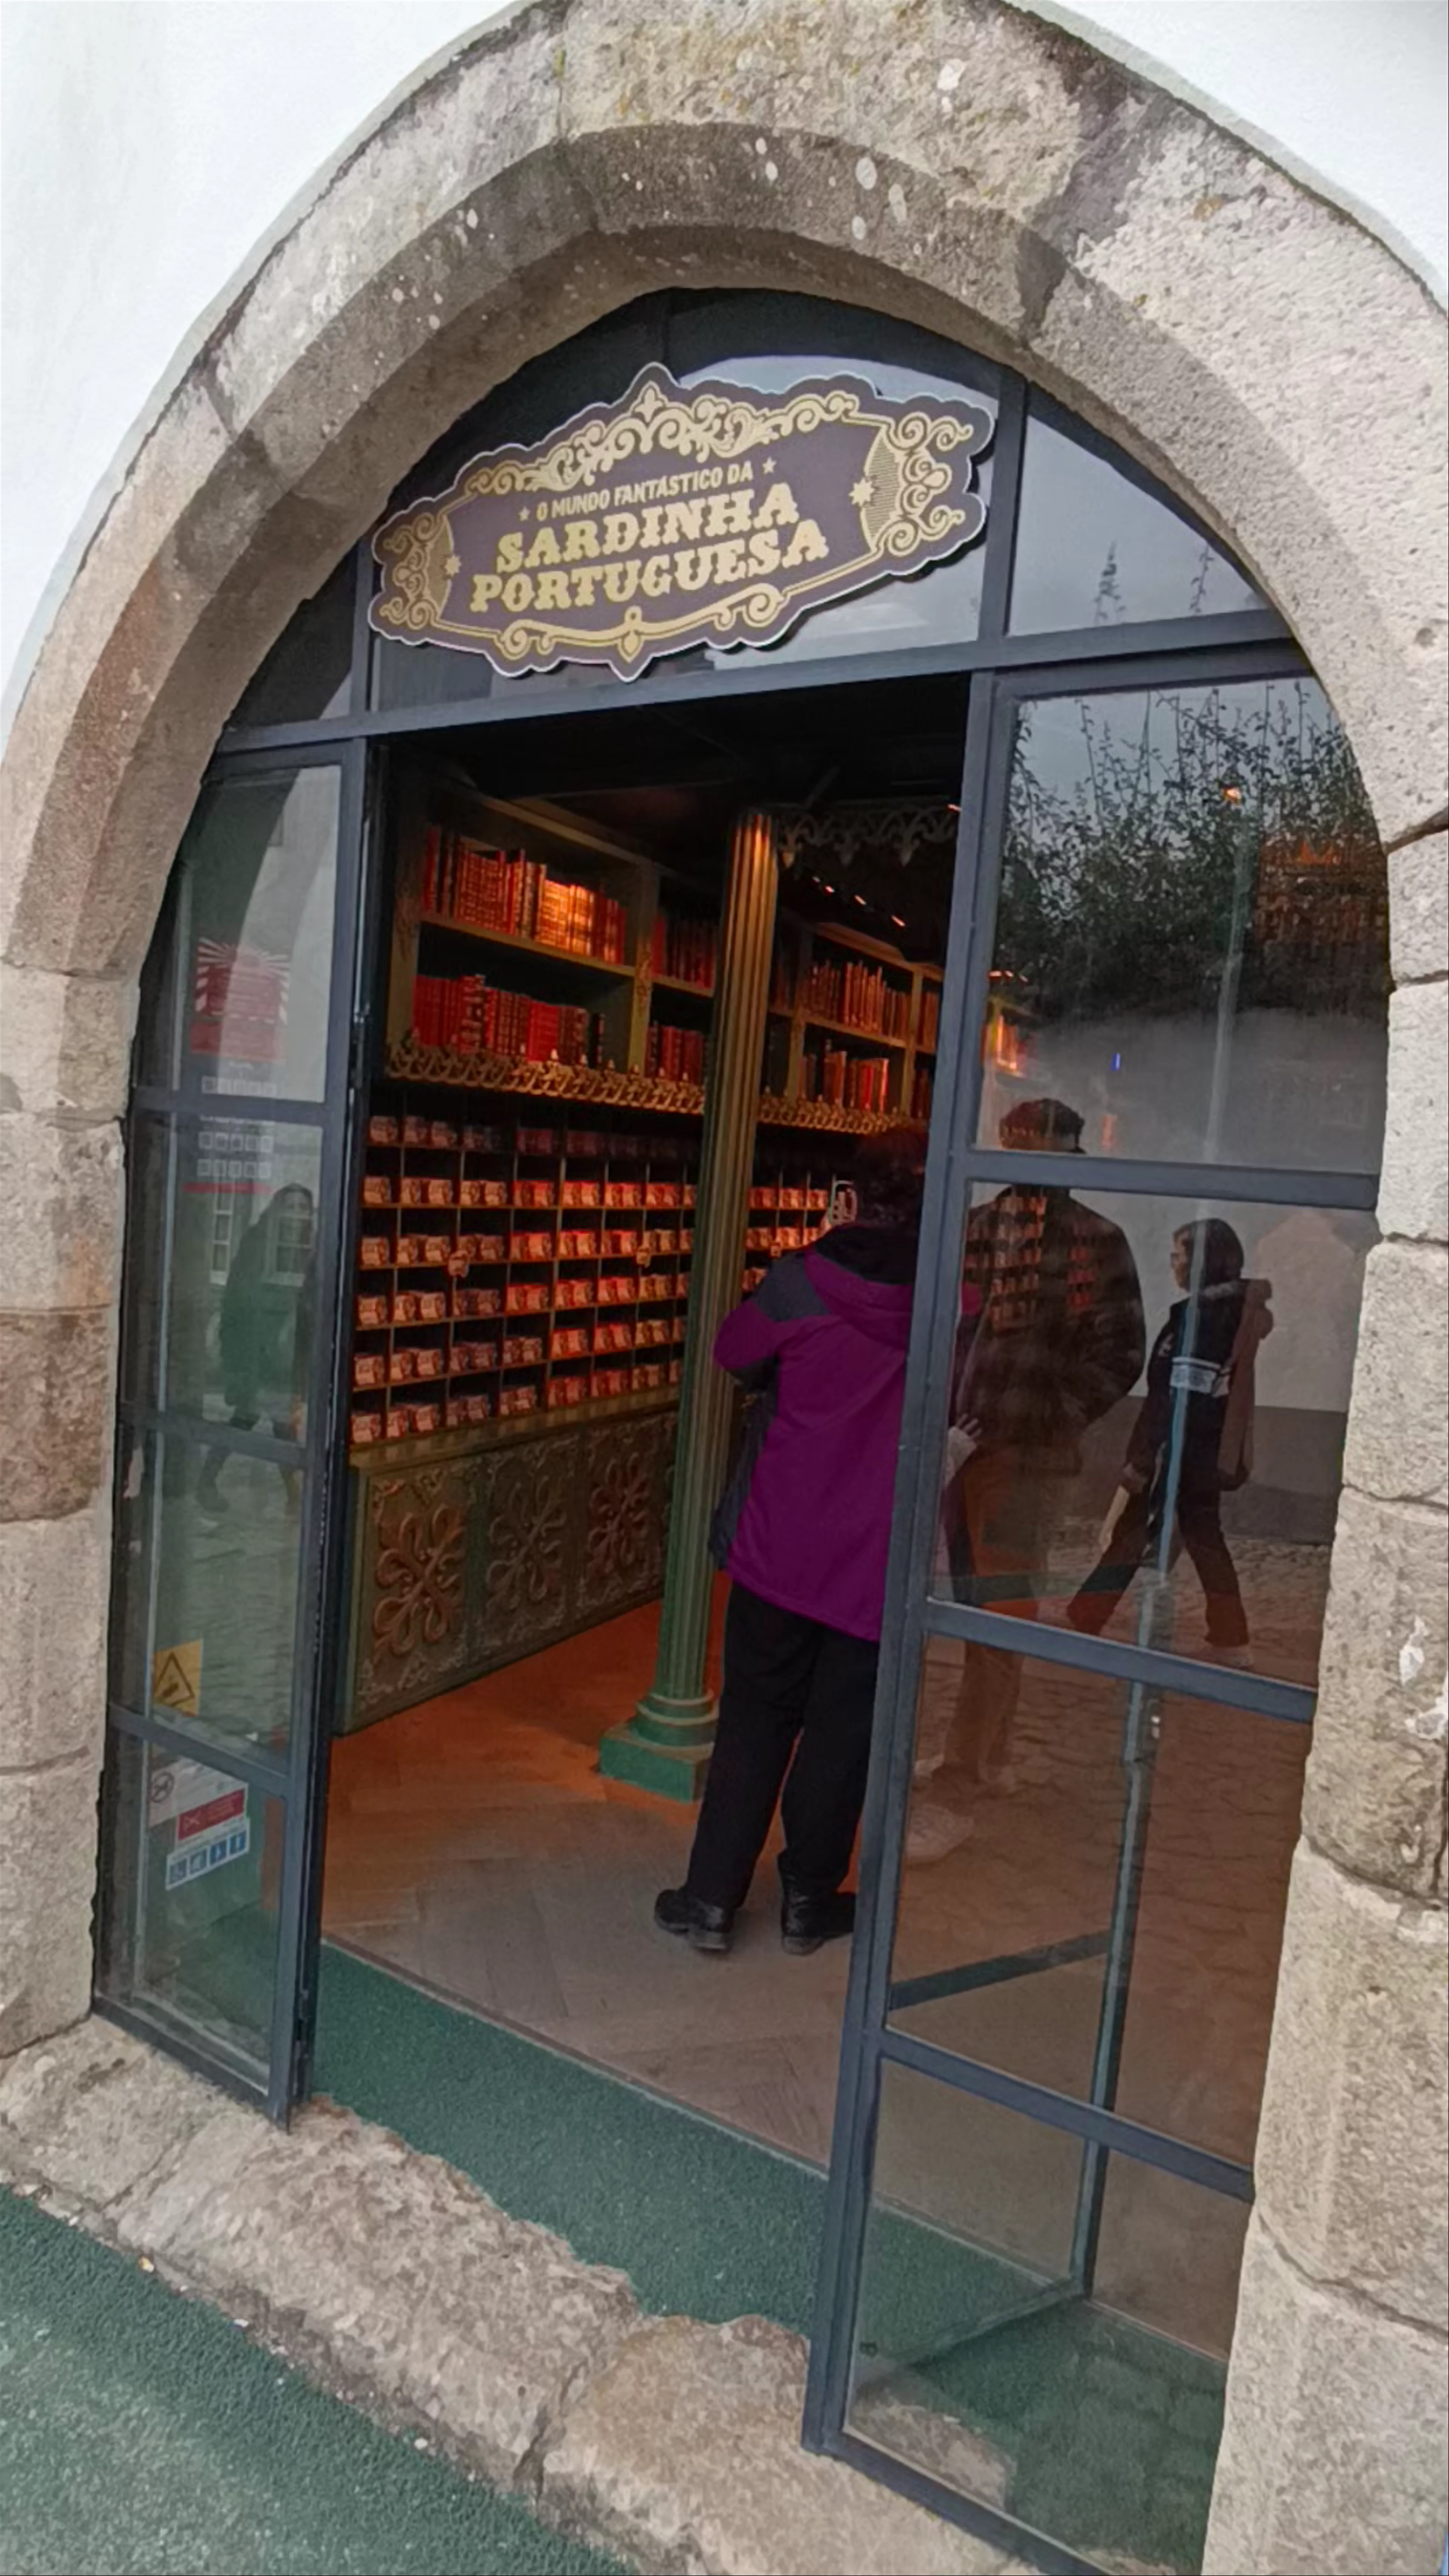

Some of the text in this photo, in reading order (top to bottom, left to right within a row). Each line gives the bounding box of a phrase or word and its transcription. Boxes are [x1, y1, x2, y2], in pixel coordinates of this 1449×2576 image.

[497, 483, 799, 574] SARDINHA
[536, 461, 753, 521] O MUNDO FANTÁSTICO DA
[469, 519, 829, 612] PORTUGUESA
